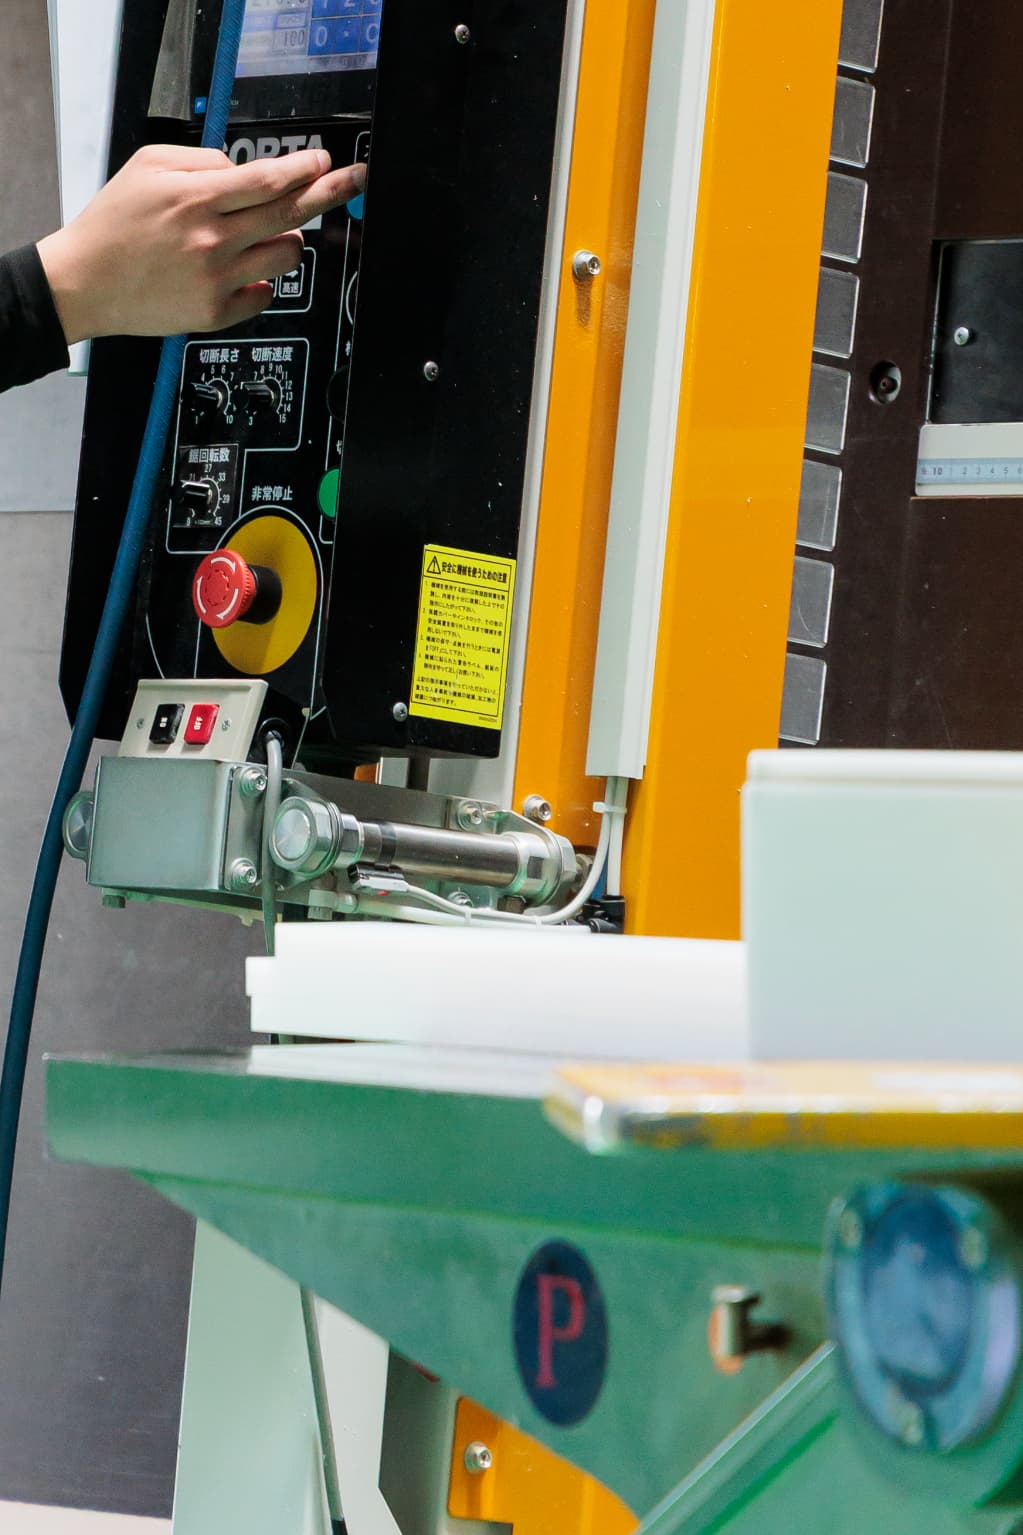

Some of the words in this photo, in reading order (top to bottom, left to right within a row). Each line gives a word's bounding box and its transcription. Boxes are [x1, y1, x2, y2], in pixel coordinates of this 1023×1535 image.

[315, 25, 328, 47] 0
[199, 348, 240, 363] 切断長さ
[251, 346, 294, 362] 切断速度
[251, 485, 293, 501] 非常停止
[159, 717, 168, 728] ON
[193, 716, 203, 730] OFF
[535, 1273, 586, 1389] P
